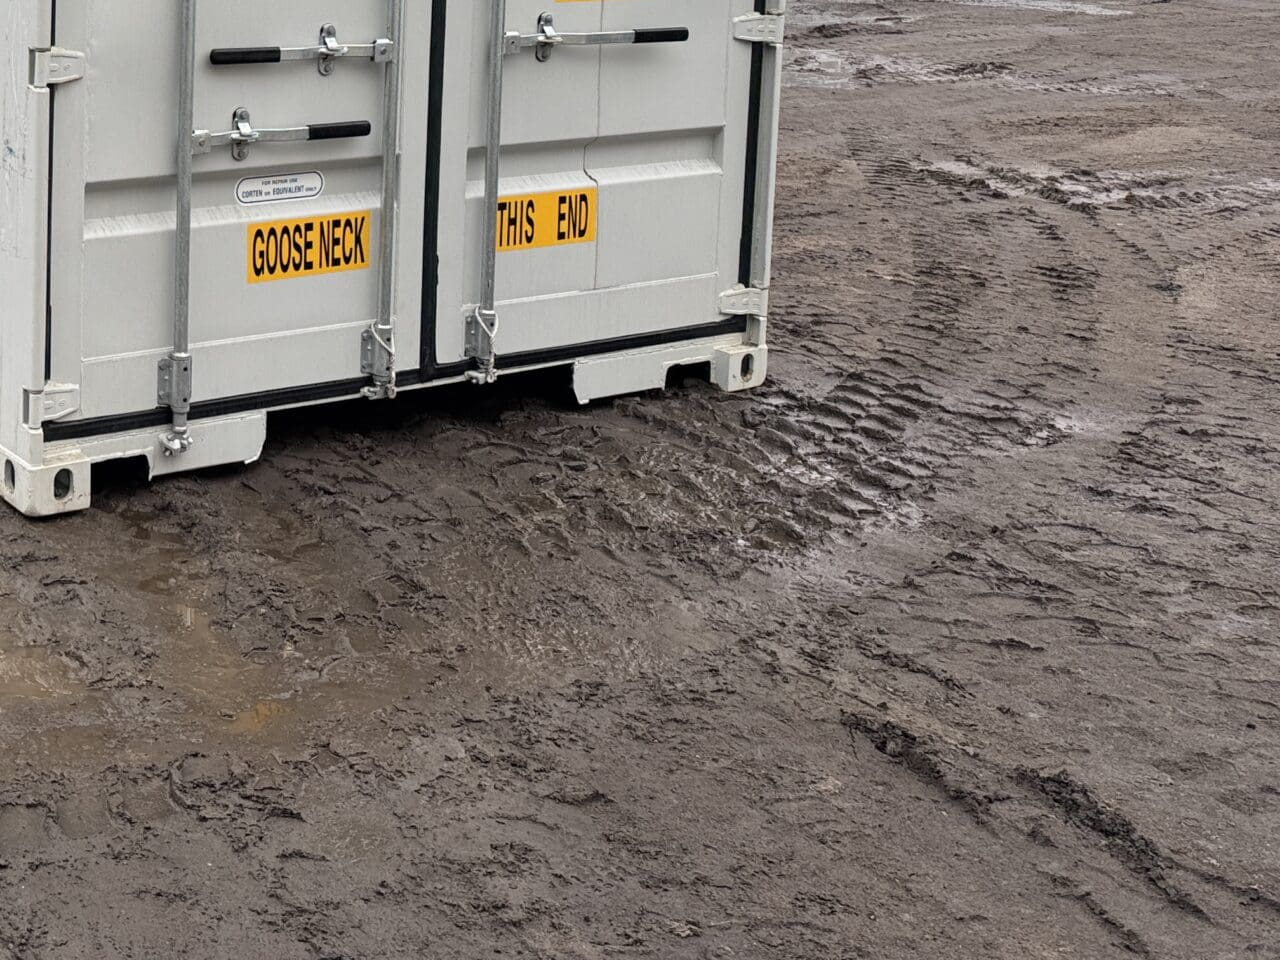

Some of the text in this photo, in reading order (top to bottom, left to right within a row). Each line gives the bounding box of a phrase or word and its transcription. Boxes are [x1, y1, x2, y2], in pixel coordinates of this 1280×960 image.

[242, 189, 263, 198] CORTEN
[272, 185, 304, 196] EQUIVALENT
[252, 216, 365, 277] GOOSE NECK
[497, 193, 588, 247] THIS END
